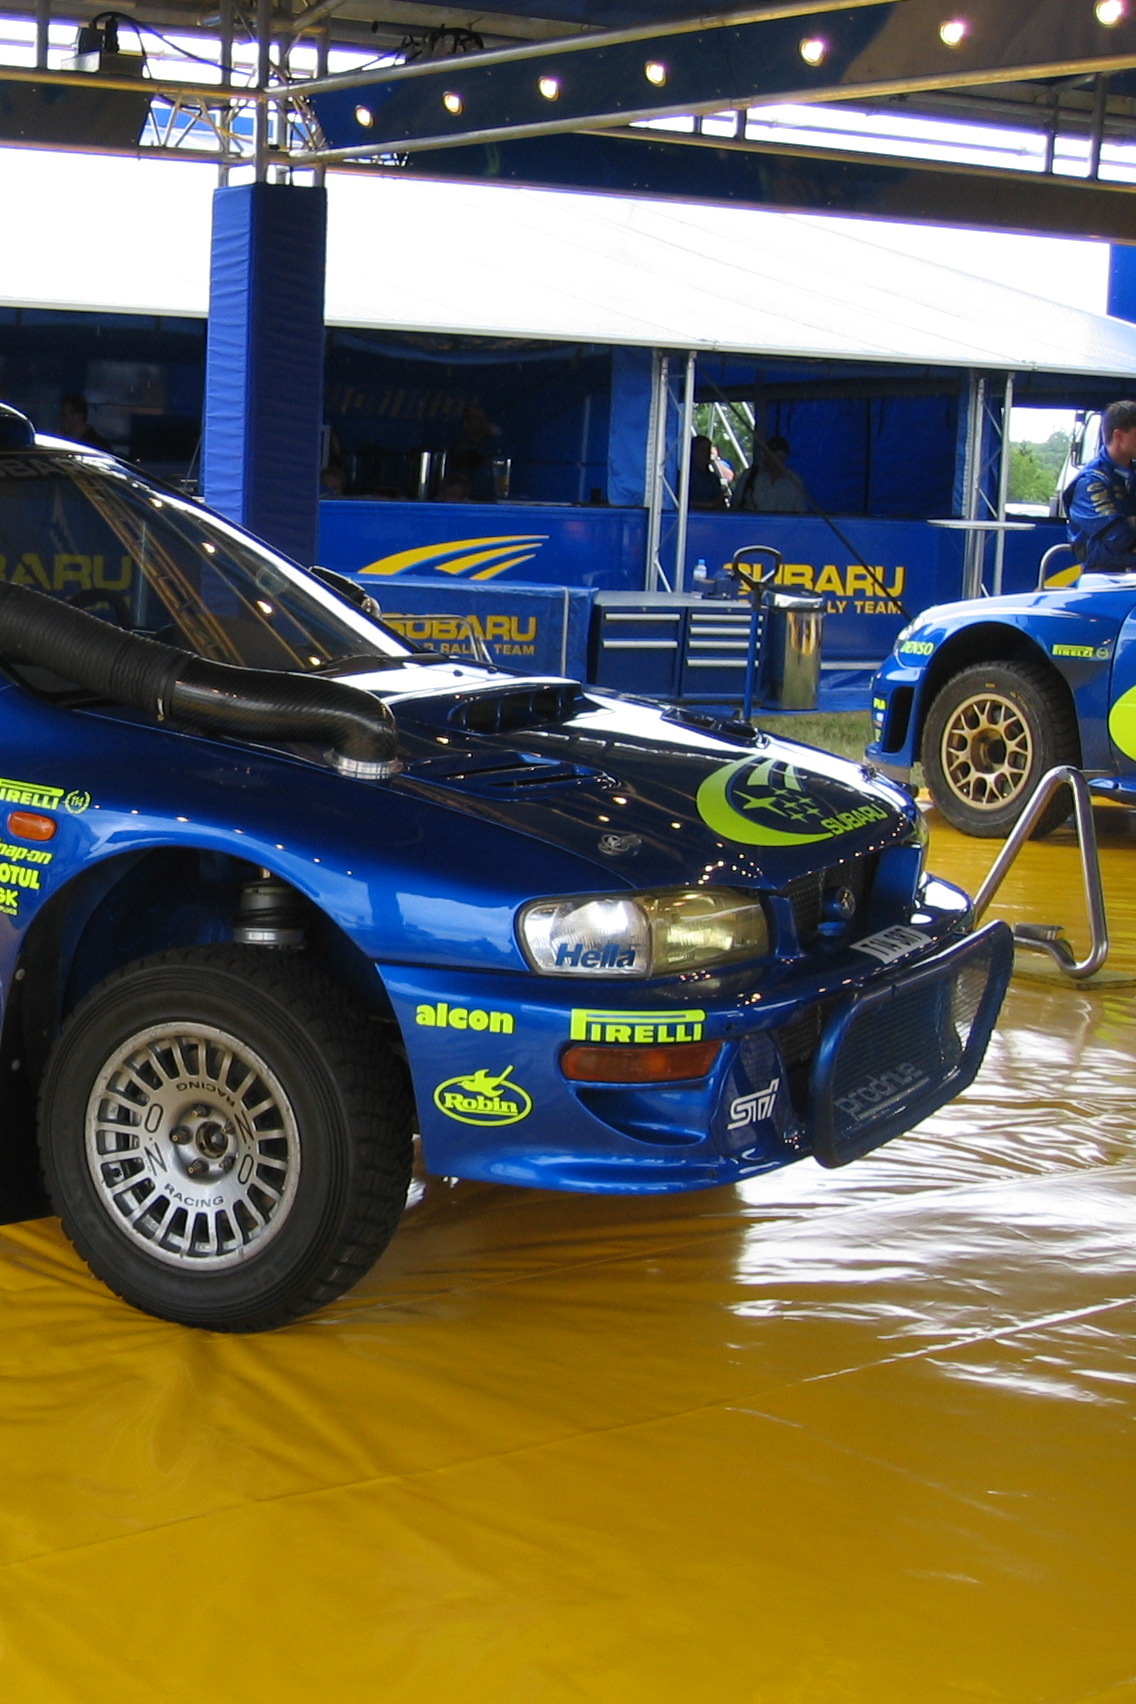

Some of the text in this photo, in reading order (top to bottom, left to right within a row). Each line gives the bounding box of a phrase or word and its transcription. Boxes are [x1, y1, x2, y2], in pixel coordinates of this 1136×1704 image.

[854, 601, 905, 614] TEAM
[494, 644, 535, 655] TEAM
[820, 803, 889, 836] SUBARU
[554, 943, 637, 968] Hella
[415, 1002, 514, 1034] alcon
[570, 1008, 707, 1043] PIRELLI
[443, 1092, 519, 1117] Robin
[163, 1182, 225, 1208] RACING
